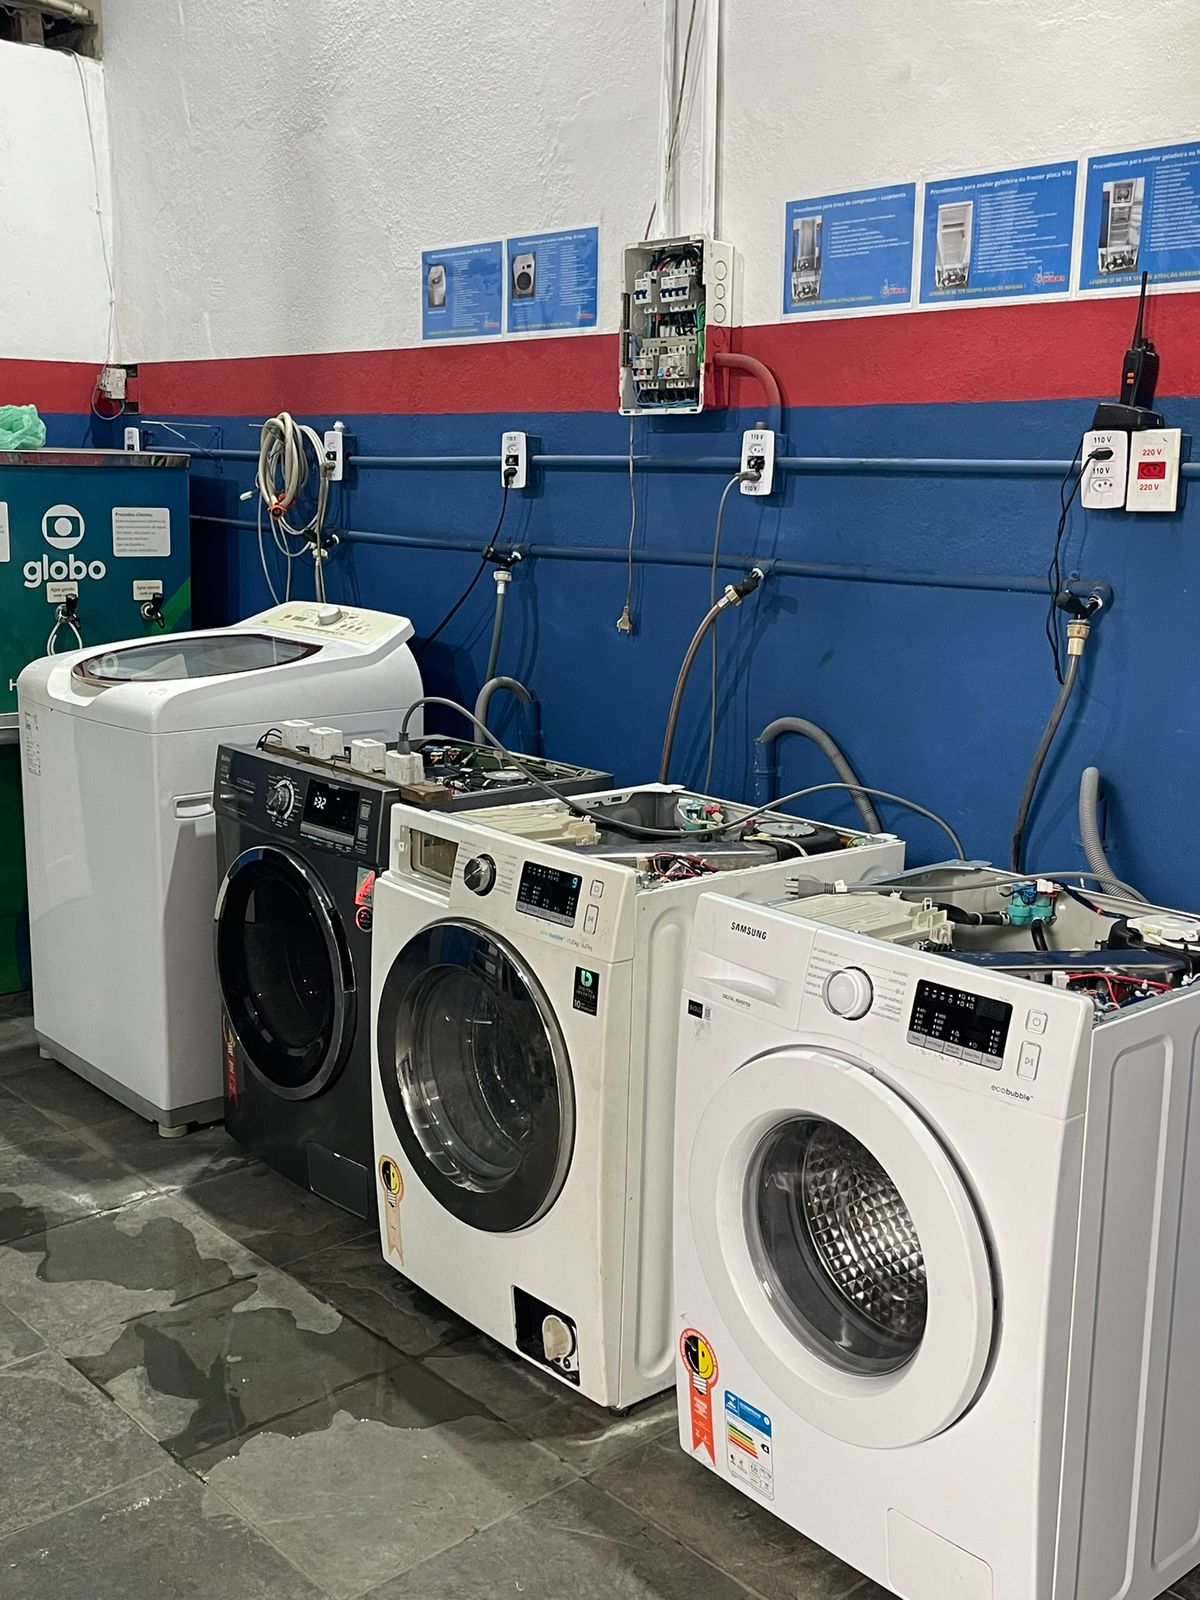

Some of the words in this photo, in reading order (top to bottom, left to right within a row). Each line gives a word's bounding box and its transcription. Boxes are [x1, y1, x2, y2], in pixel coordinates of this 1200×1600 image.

[1061, 169, 1072, 177] fria
[1093, 436, 1105, 444] 110
[1142, 448, 1156, 456] 220
[1156, 448, 1162, 456] V
[1139, 483, 1153, 491] 220
[1154, 483, 1160, 491] V
[23, 553, 106, 588] globo
[572, 877, 579, 888] 9
[730, 921, 767, 940] SAMSUNG
[991, 1085, 1031, 1101] ecobubble
